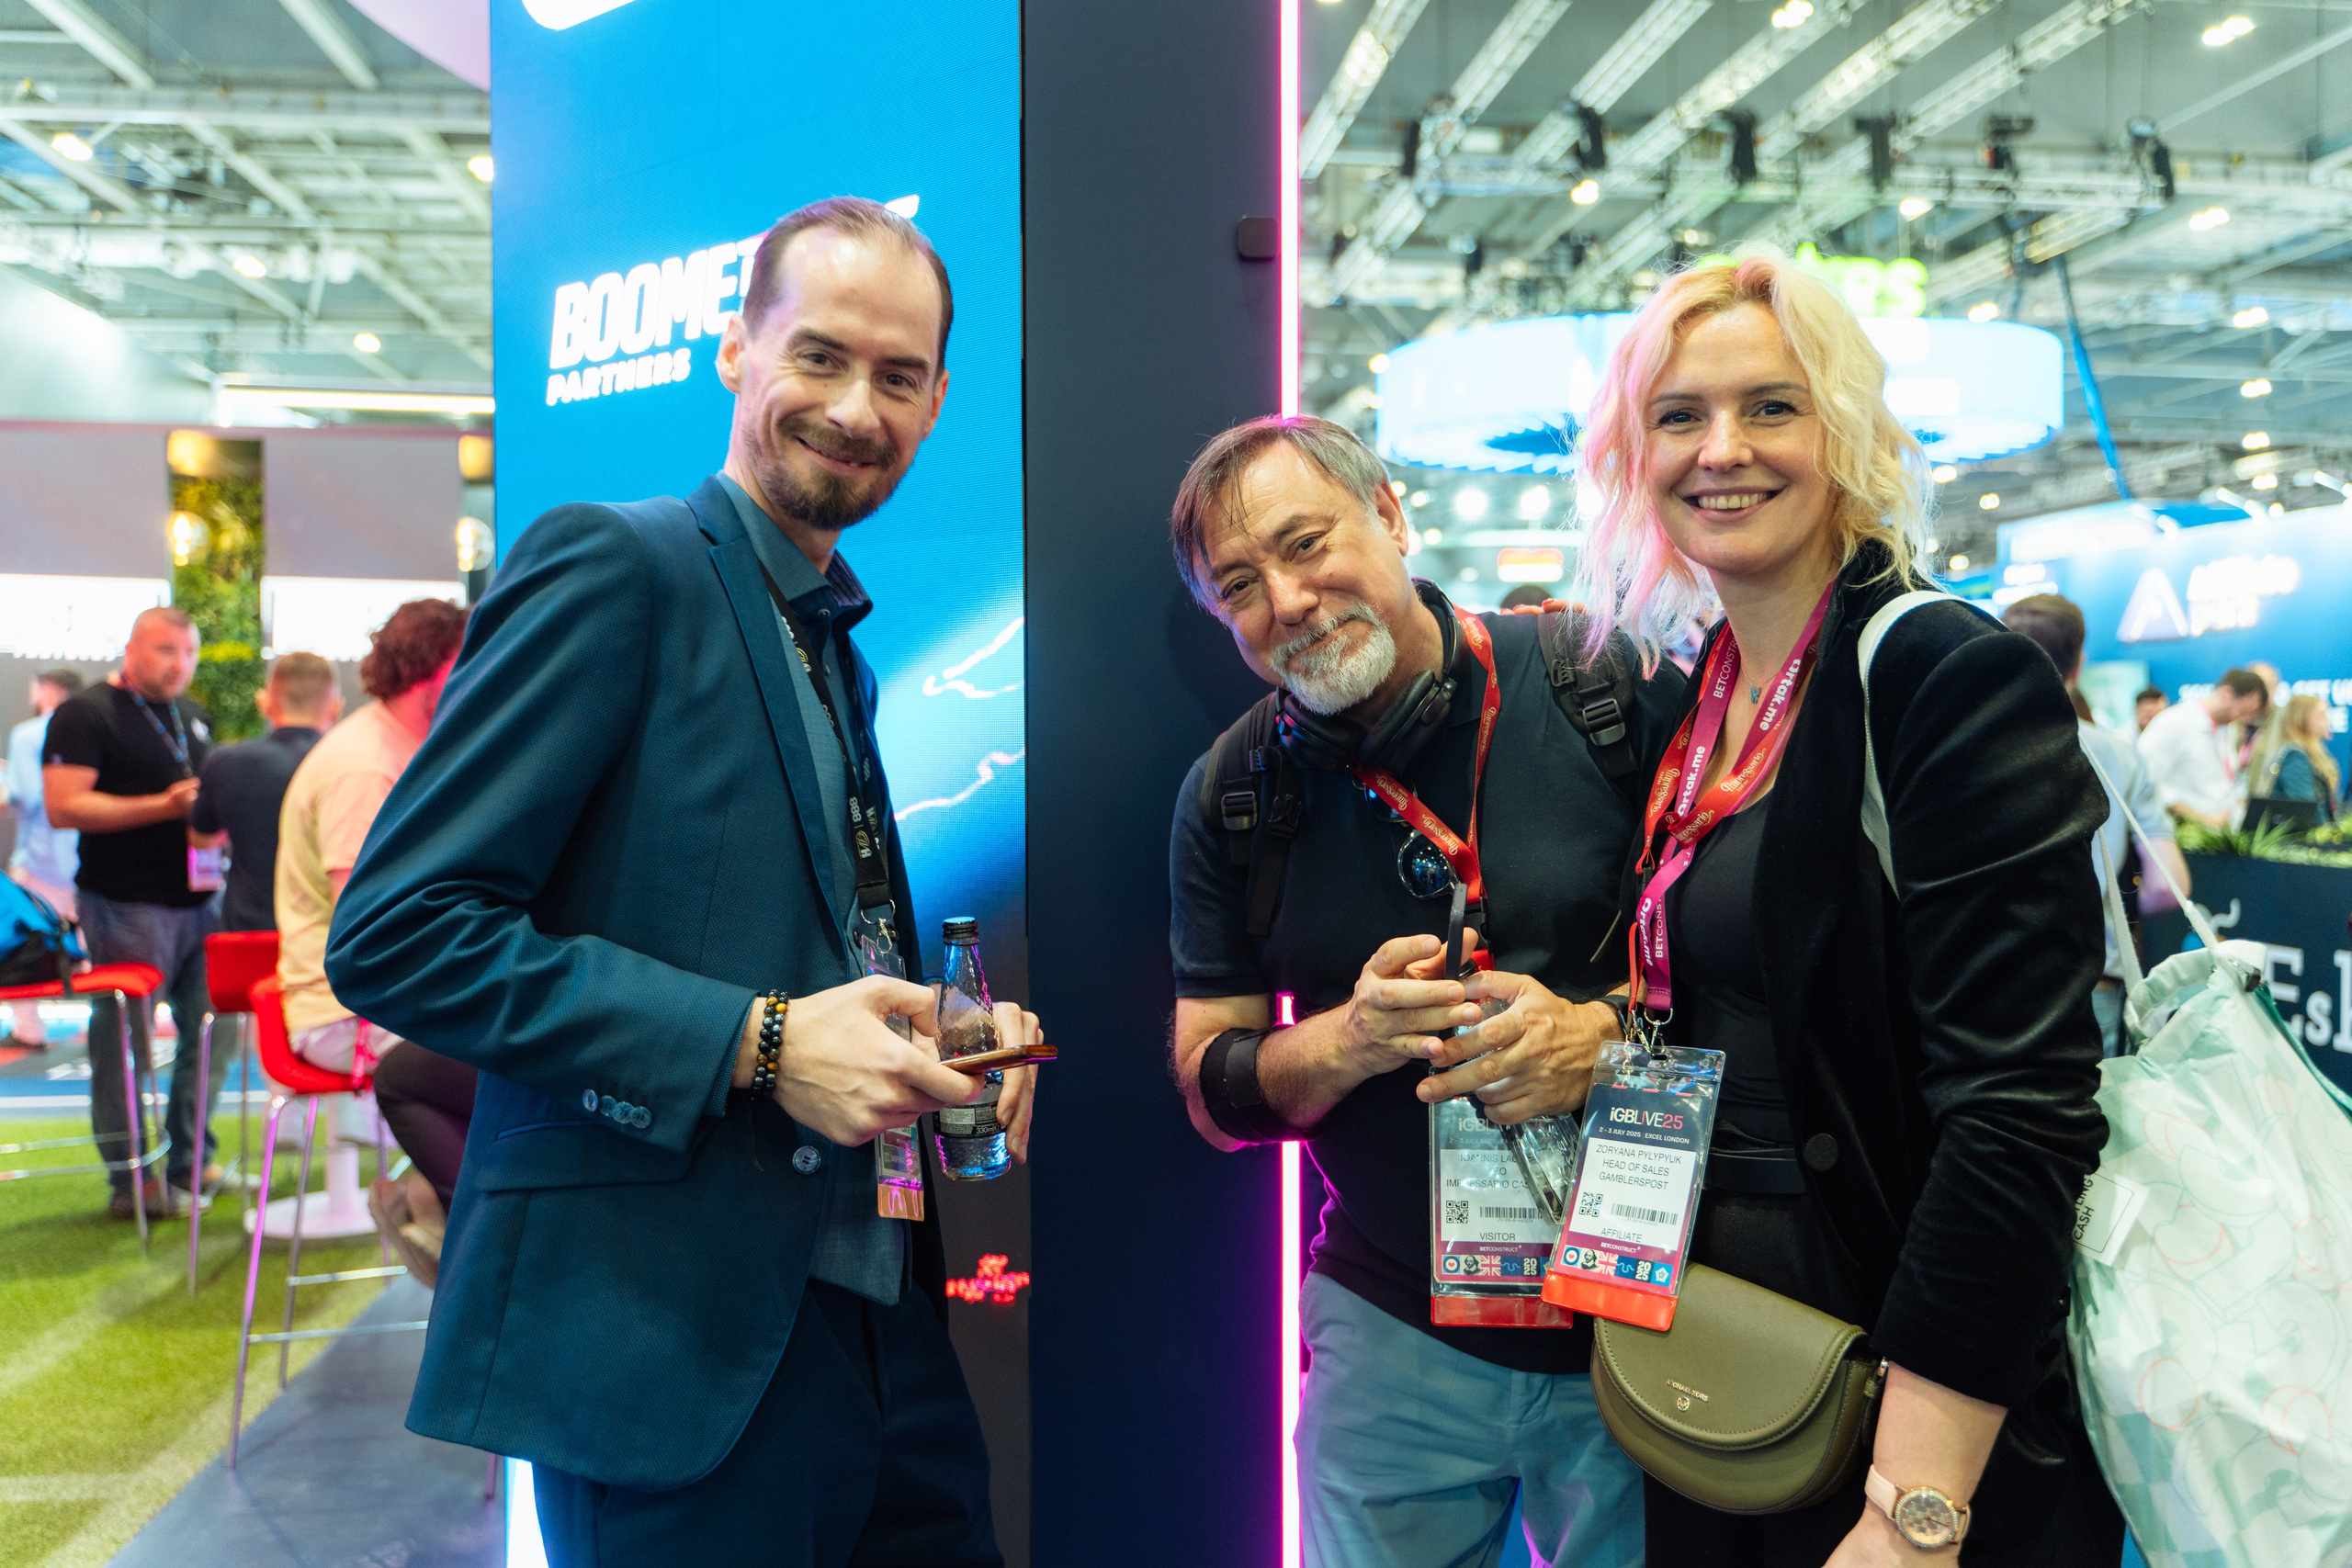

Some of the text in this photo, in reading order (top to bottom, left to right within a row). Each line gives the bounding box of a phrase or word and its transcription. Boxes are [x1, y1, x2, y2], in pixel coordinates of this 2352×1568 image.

[546, 347, 691, 406] PARTNERS
[850, 796, 862, 822] 888
[1609, 1106, 1684, 1130] iGBLIVE25
[1626, 1130, 1642, 1138] 2025
[1664, 1136, 1690, 1145] LONDON
[1596, 1145, 1682, 1165] ZORYANA PYLYPYUK
[1602, 1159, 1669, 1177] HEAD OF SALES
[1599, 1172, 1668, 1190] GAMBLERSPOST
[2074, 1205, 2095, 1240] CASH
[1479, 1232, 1516, 1241] VISITOR
[1600, 1228, 1642, 1243] AFFILIATE
[1523, 1258, 1537, 1268] 20
[1523, 1266, 1537, 1276] 25
[1638, 1260, 1652, 1271] 20
[1634, 1269, 1649, 1281] 25
